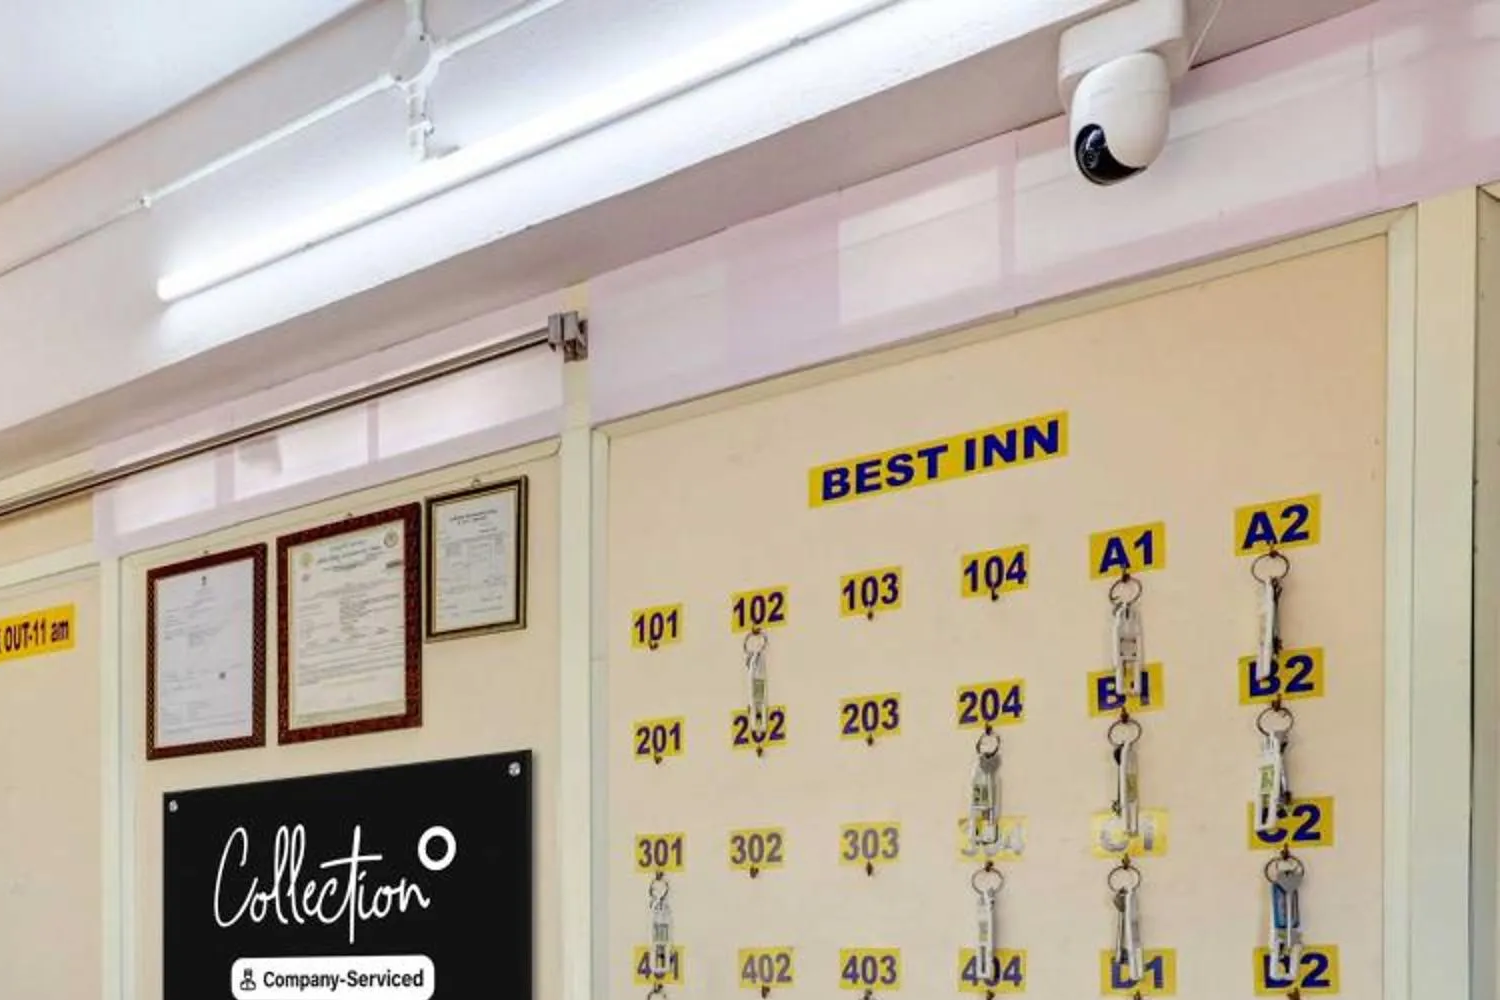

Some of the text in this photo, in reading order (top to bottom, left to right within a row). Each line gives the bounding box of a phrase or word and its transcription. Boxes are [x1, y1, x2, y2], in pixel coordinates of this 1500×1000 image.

[822, 419, 1059, 501] BEST INN
[1242, 504, 1309, 549] A2
[1098, 530, 1153, 574] A1
[963, 551, 1027, 593] 104
[733, 591, 786, 627] 102
[843, 572, 899, 611] 103
[51, 620, 69, 642] am
[634, 610, 678, 643] 101
[1248, 654, 1314, 697] B2
[841, 699, 899, 735] 203
[958, 685, 1023, 725] 204
[636, 721, 681, 754] 201
[638, 836, 683, 867] 301
[730, 832, 783, 865] 302
[842, 827, 899, 861] 303
[214, 824, 431, 945] Collection
[263, 968, 424, 992] Company-Serviced
[742, 953, 792, 984] 402
[842, 955, 896, 984] 403
